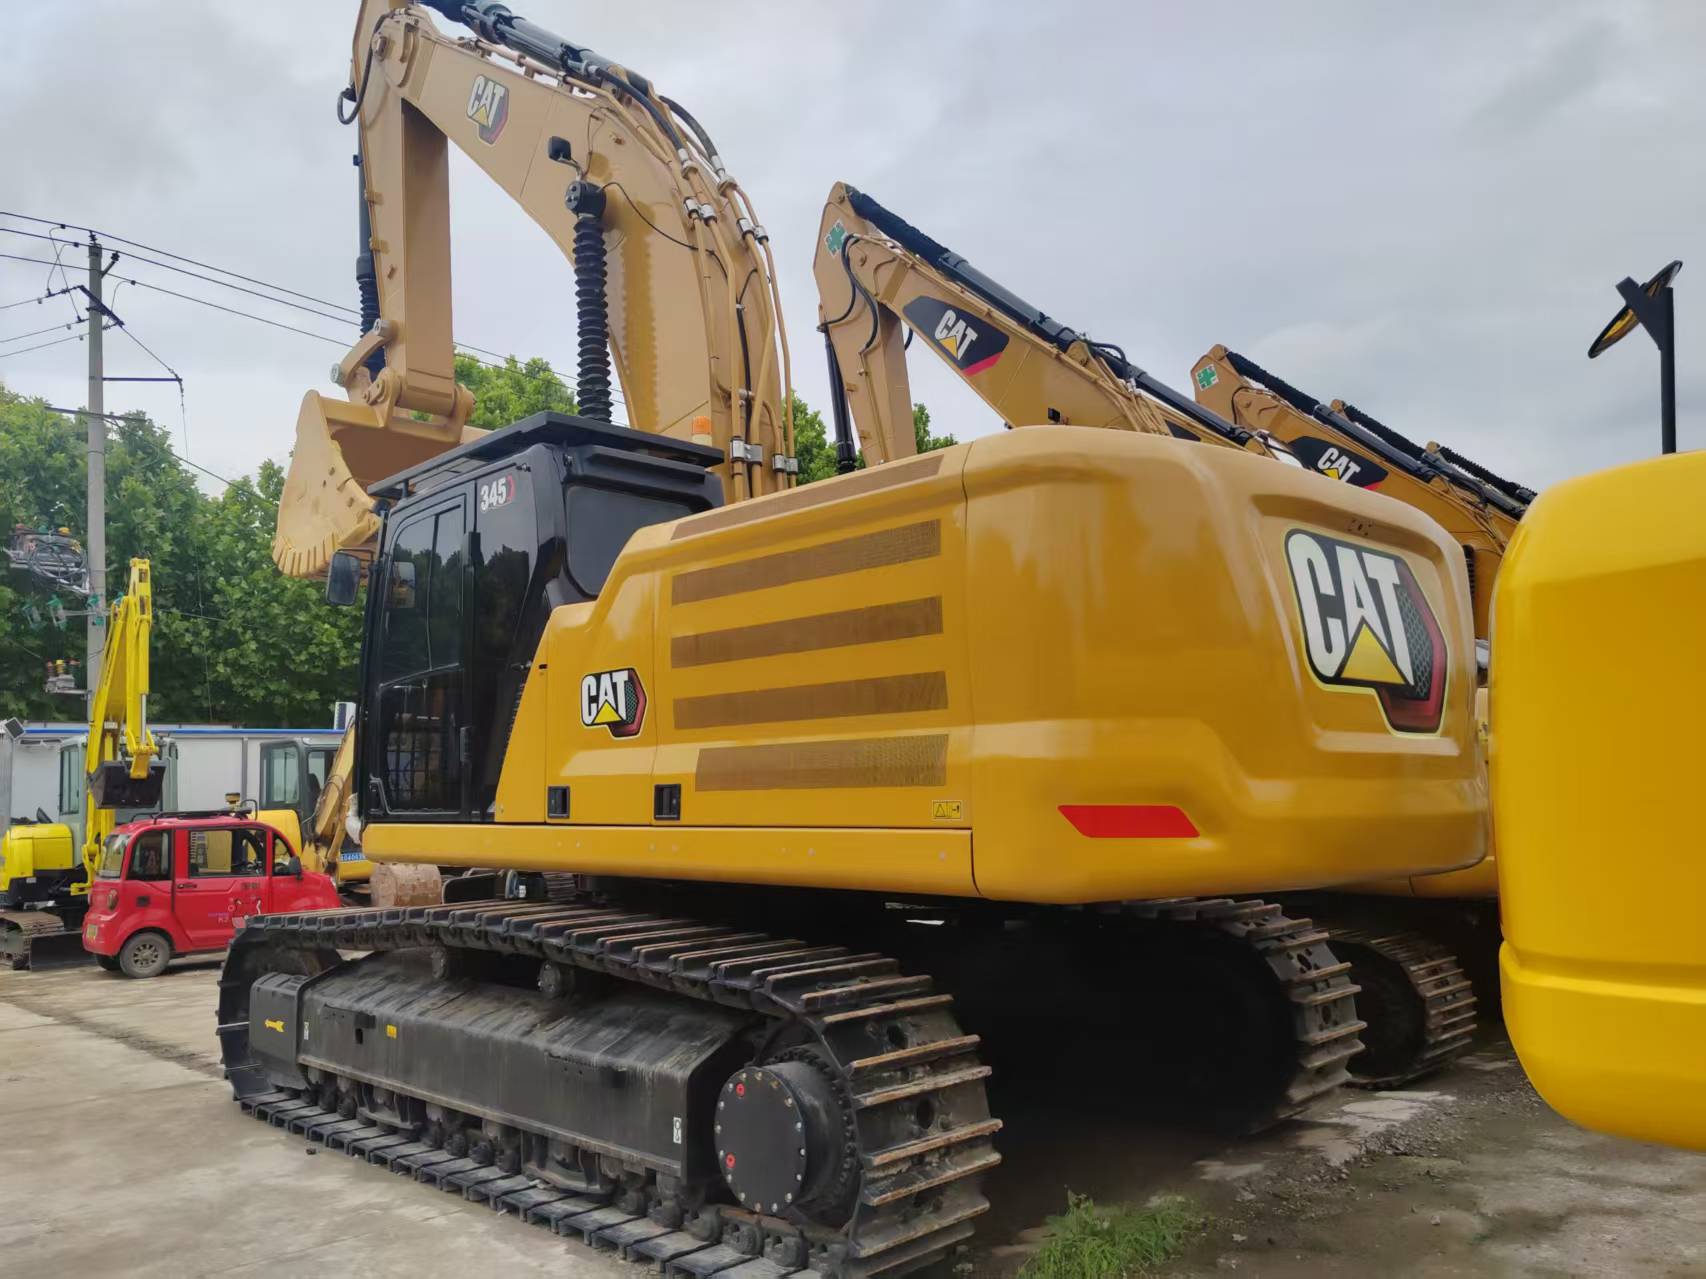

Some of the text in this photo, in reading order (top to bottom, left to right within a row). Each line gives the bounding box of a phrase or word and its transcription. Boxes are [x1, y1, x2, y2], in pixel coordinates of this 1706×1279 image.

[467, 75, 506, 128] CAT
[935, 309, 978, 360] CAT
[1317, 447, 1361, 482] CAT
[480, 476, 507, 511] 345
[1288, 533, 1415, 686] CAT
[581, 670, 628, 725] CAT
